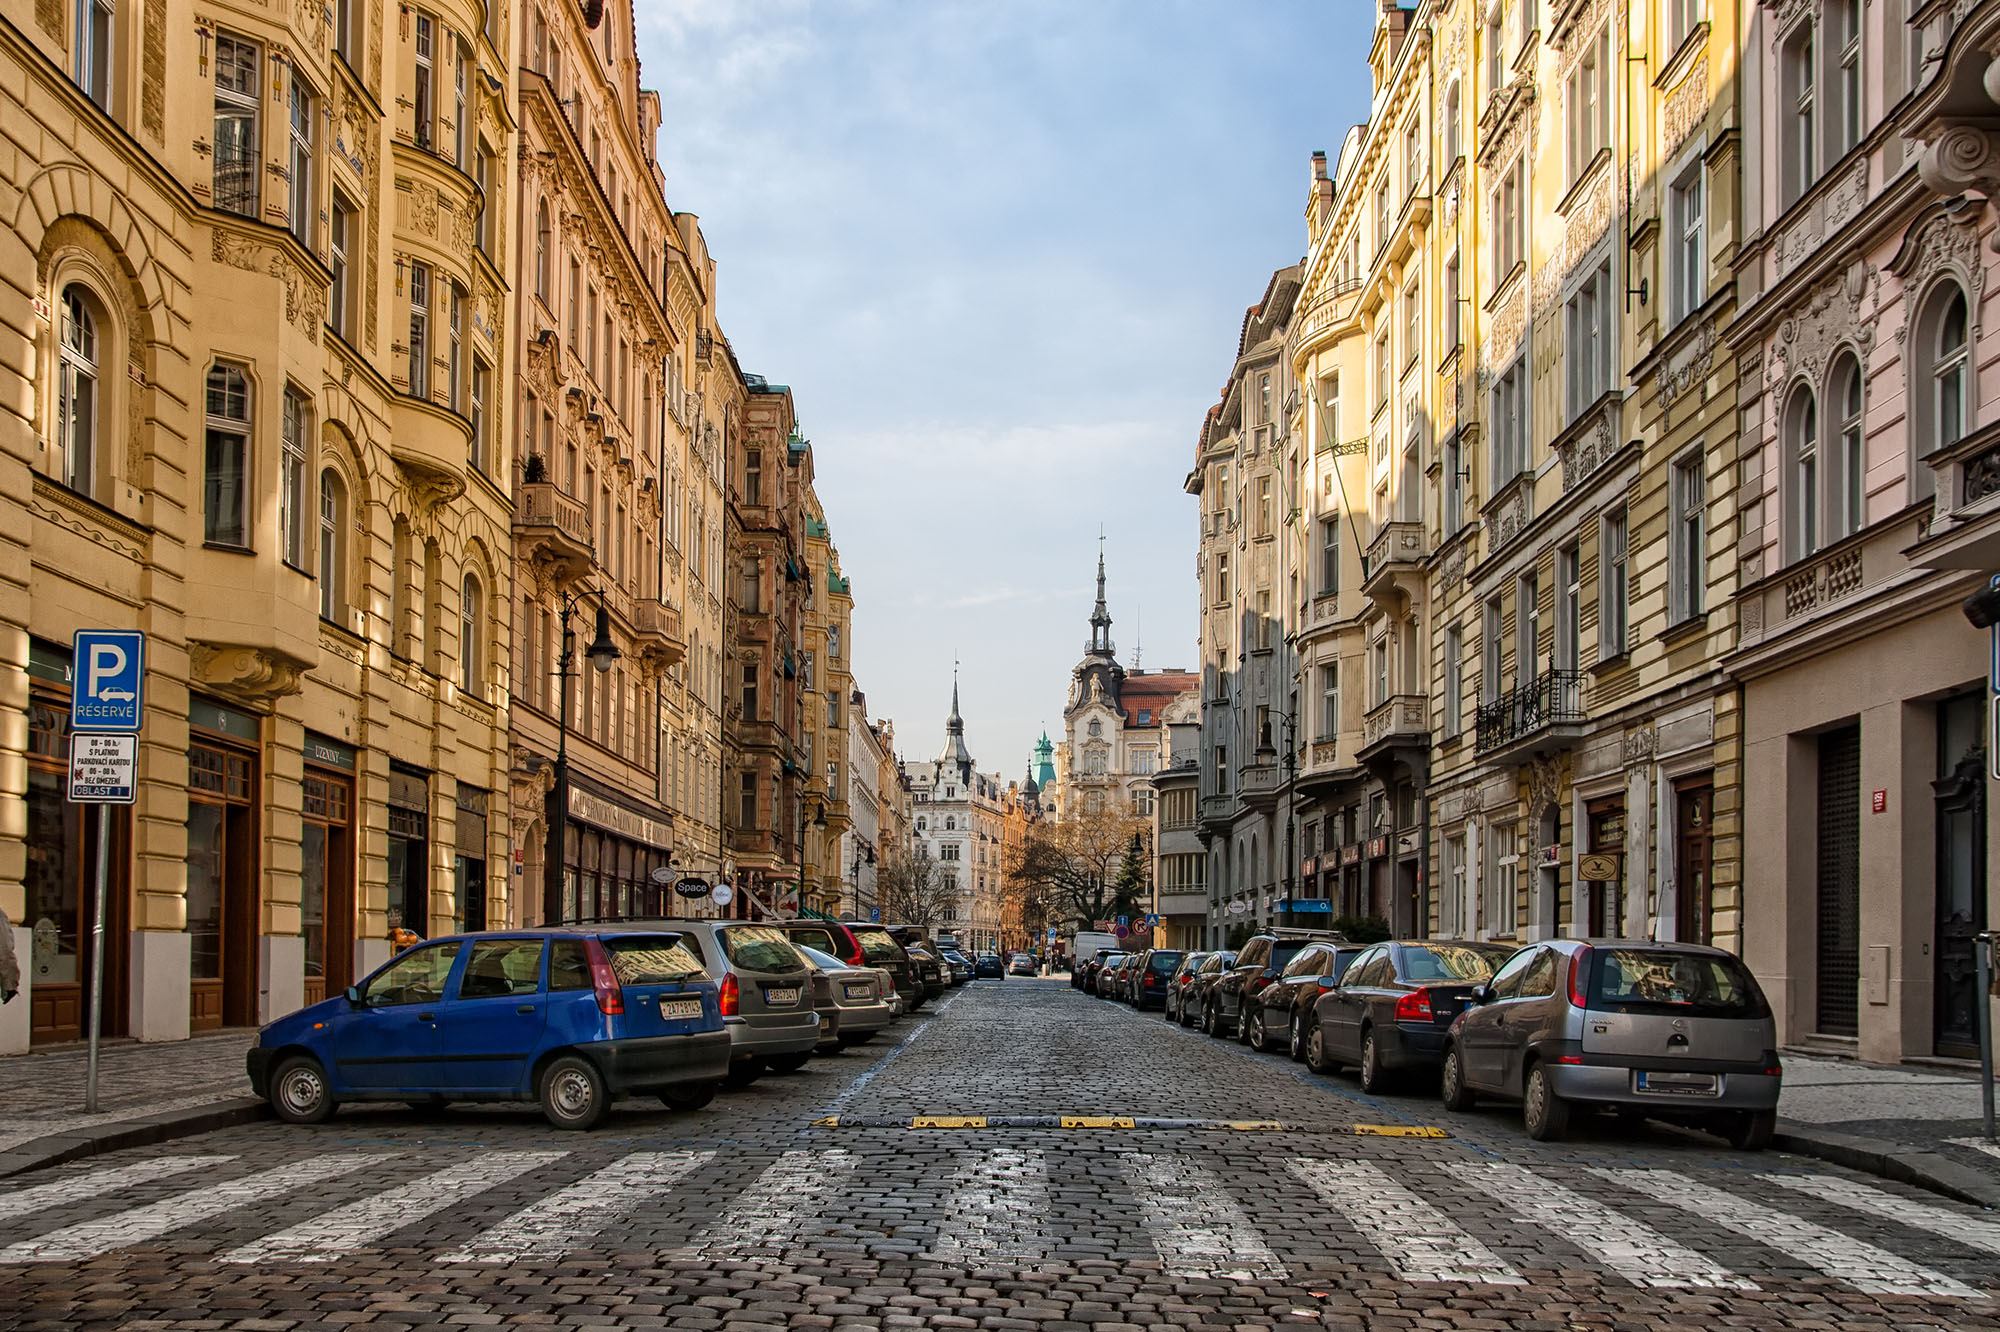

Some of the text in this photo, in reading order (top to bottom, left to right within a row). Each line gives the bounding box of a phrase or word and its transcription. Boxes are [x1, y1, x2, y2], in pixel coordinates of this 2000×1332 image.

[88, 643, 127, 697] P
[77, 702, 134, 718] RÉSERVÉ
[89, 748, 119, 757] S PLATNOU
[77, 756, 130, 767] PARKOVACÍ KARTOU
[96, 775, 121, 785] OMEZENÍ
[76, 786, 111, 796] OBLAST
[677, 882, 707, 893] Space
